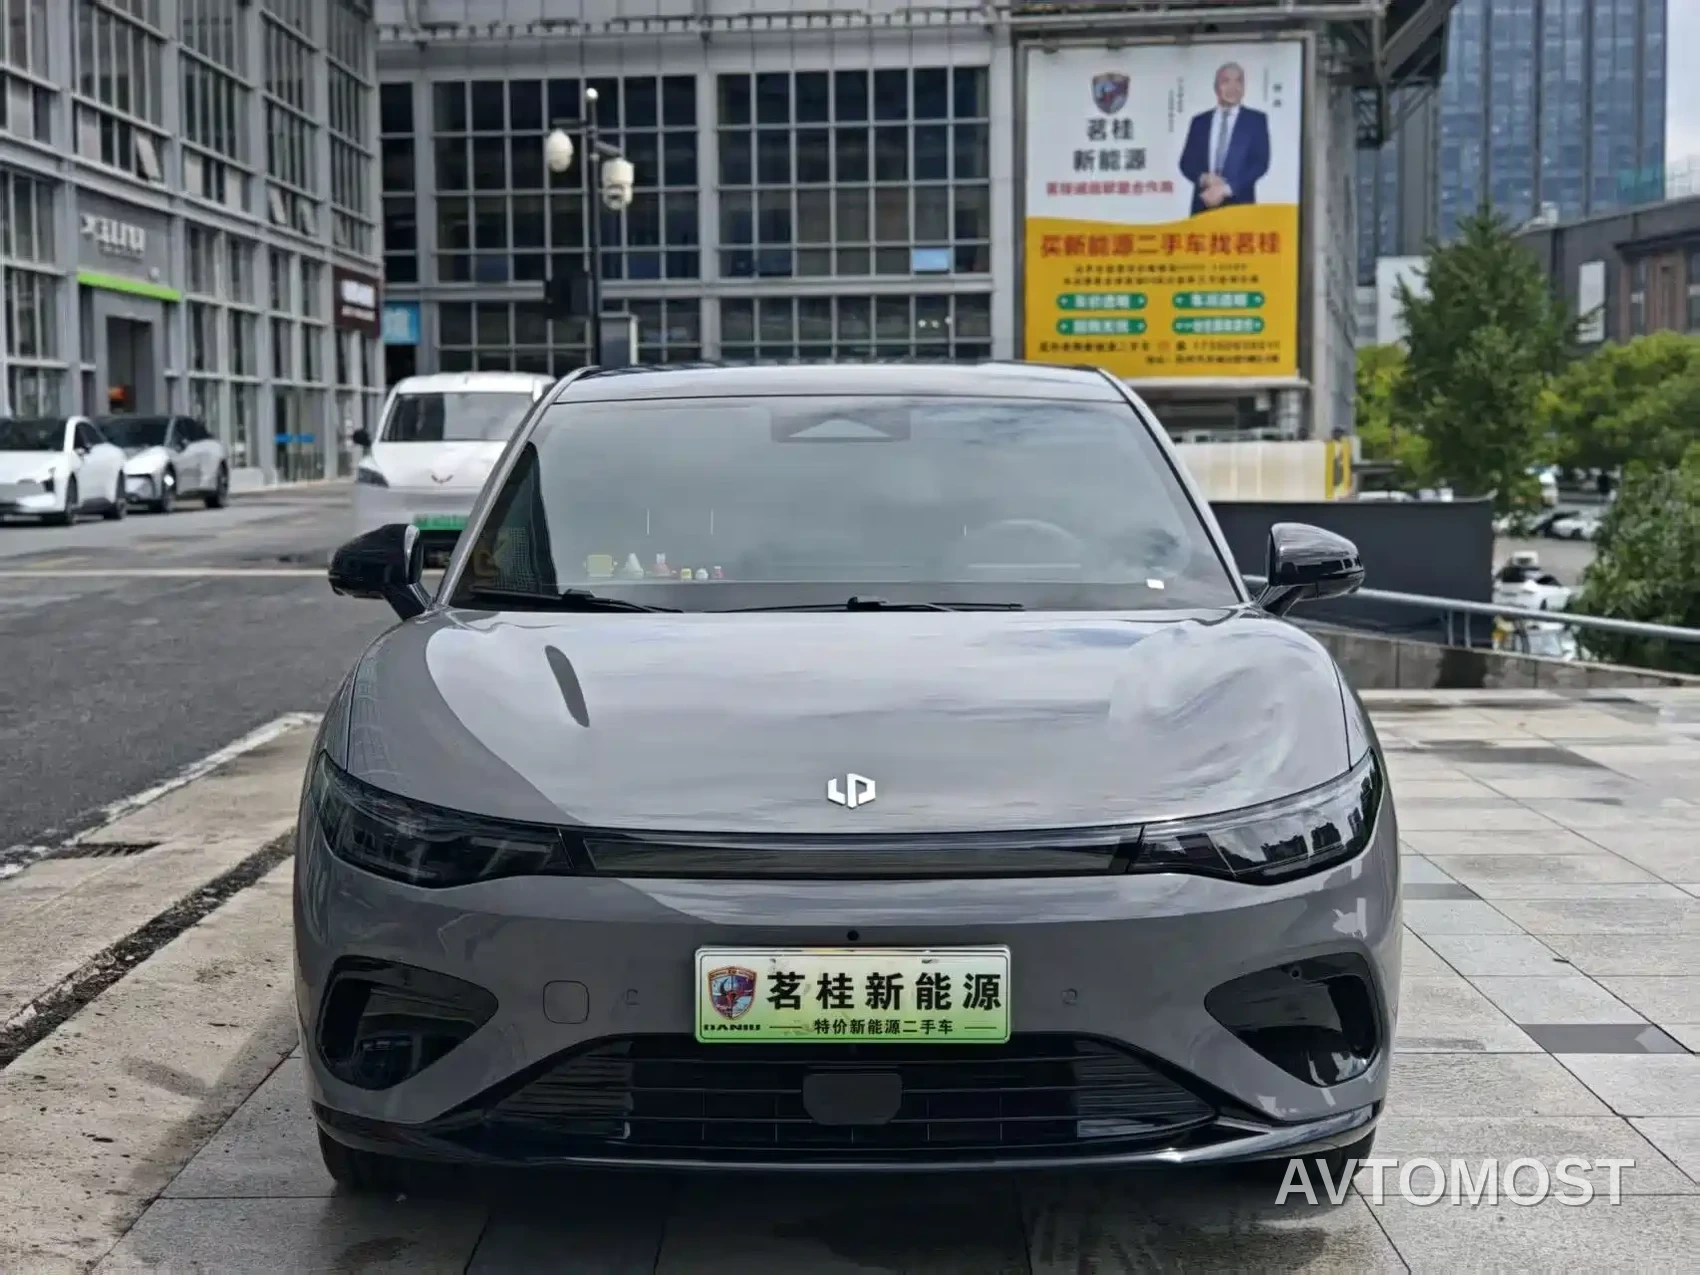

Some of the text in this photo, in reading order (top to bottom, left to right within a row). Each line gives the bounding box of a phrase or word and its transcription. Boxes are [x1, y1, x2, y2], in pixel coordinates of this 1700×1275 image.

[1086, 118, 1134, 142] 茗桂
[1072, 147, 1147, 172] 新能源
[1040, 232, 1281, 258] 买新能源二手车找茗桂
[766, 971, 1001, 1011] 茗桂新能源
[813, 1018, 954, 1035] 特价新能源二手车
